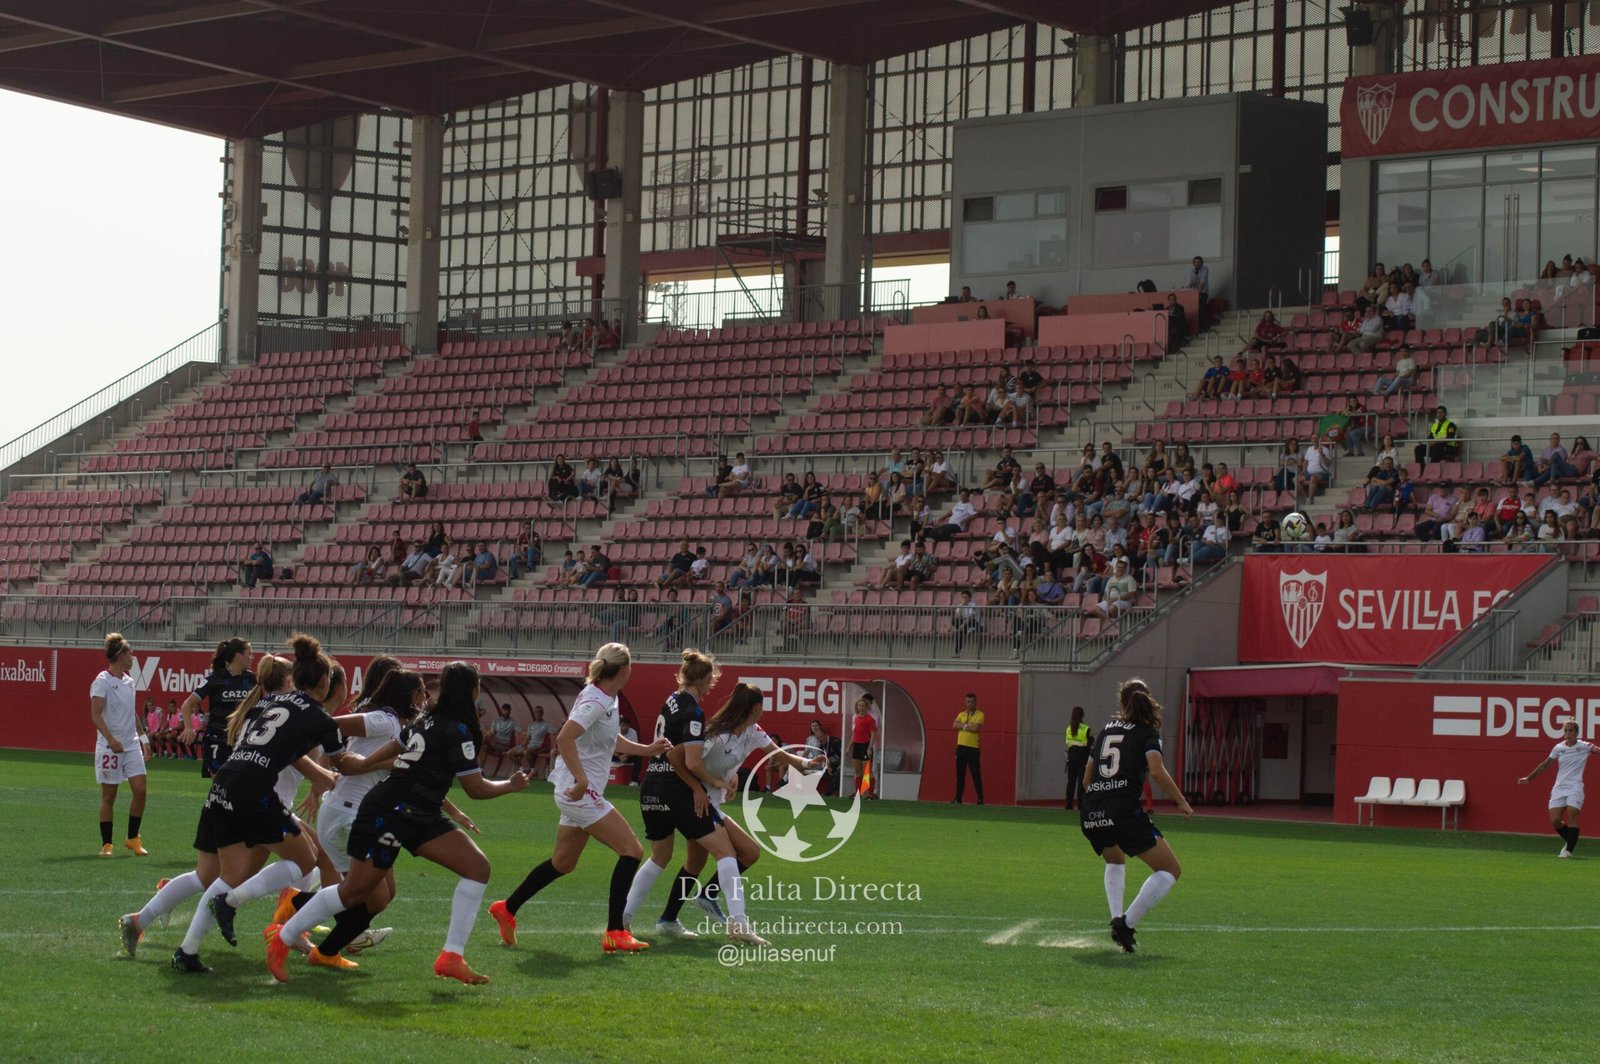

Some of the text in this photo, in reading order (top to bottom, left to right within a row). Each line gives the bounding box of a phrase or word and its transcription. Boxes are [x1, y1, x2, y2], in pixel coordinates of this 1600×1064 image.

[1337, 588, 1462, 630] SEVILLA
[526, 663, 552, 673] DEGIRO
[210, 744, 219, 759] 7
[1099, 734, 1125, 778] 5
[102, 754, 119, 770] 23
